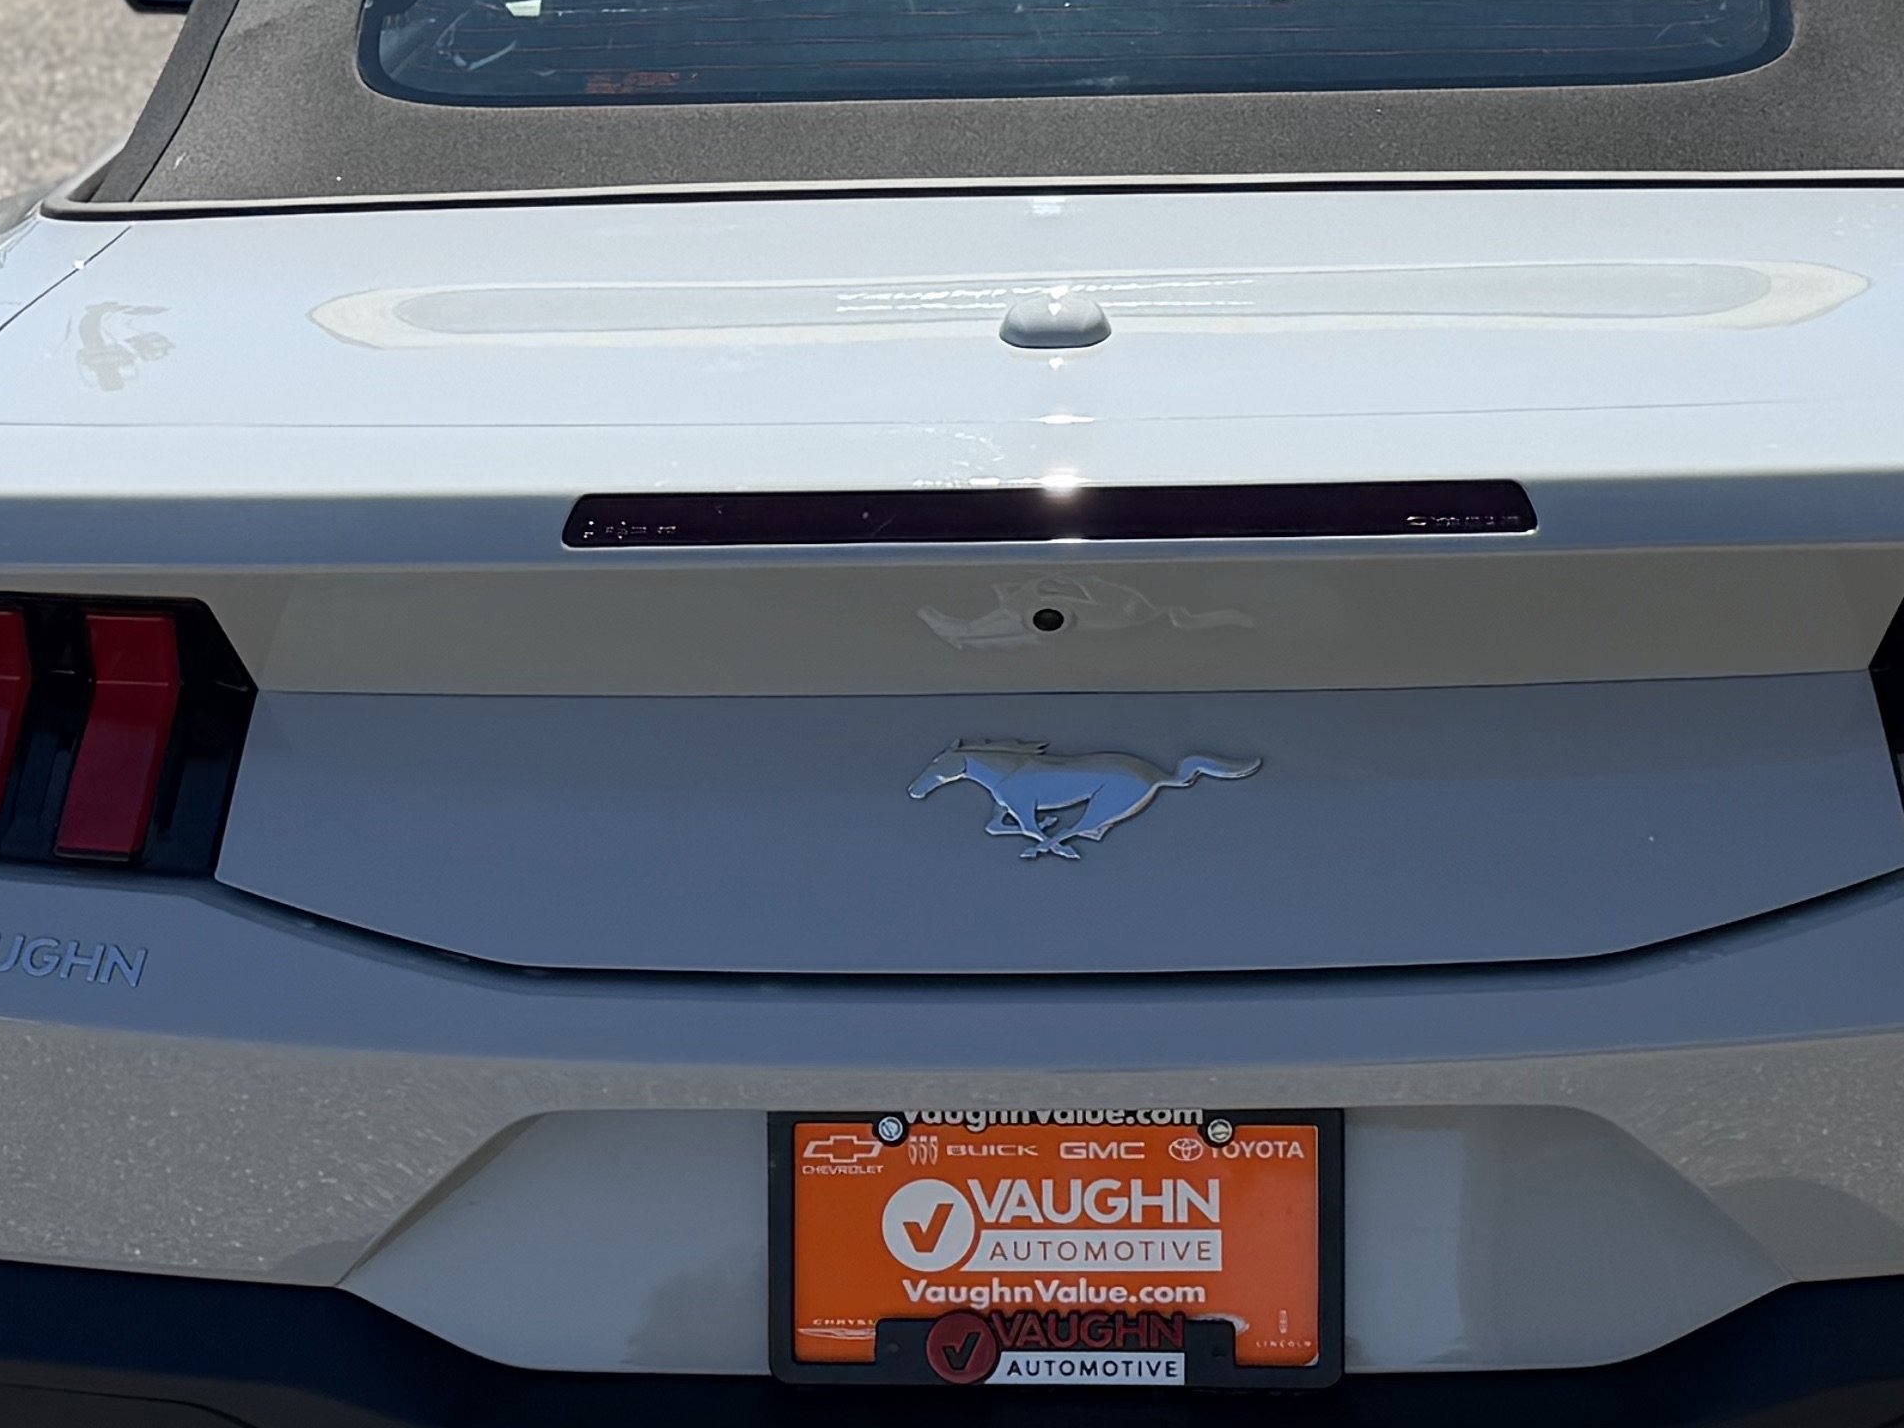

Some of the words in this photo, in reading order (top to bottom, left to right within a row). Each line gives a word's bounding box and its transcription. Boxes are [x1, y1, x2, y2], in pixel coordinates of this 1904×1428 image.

[946, 1144, 1039, 1157] BUICK
[1059, 1141, 1145, 1160] GMC
[802, 1164, 884, 1175] CHEVROLET
[966, 1178, 1221, 1224] VAUGHN
[988, 1240, 1214, 1262] AUTOMOTIVE
[902, 1276, 1206, 1310] VaughnValue.com
[812, 1318, 876, 1326] CHRYSL
[990, 1310, 1186, 1349] VAUGHN
[1006, 1359, 1179, 1378] AUTOMOTIVE
